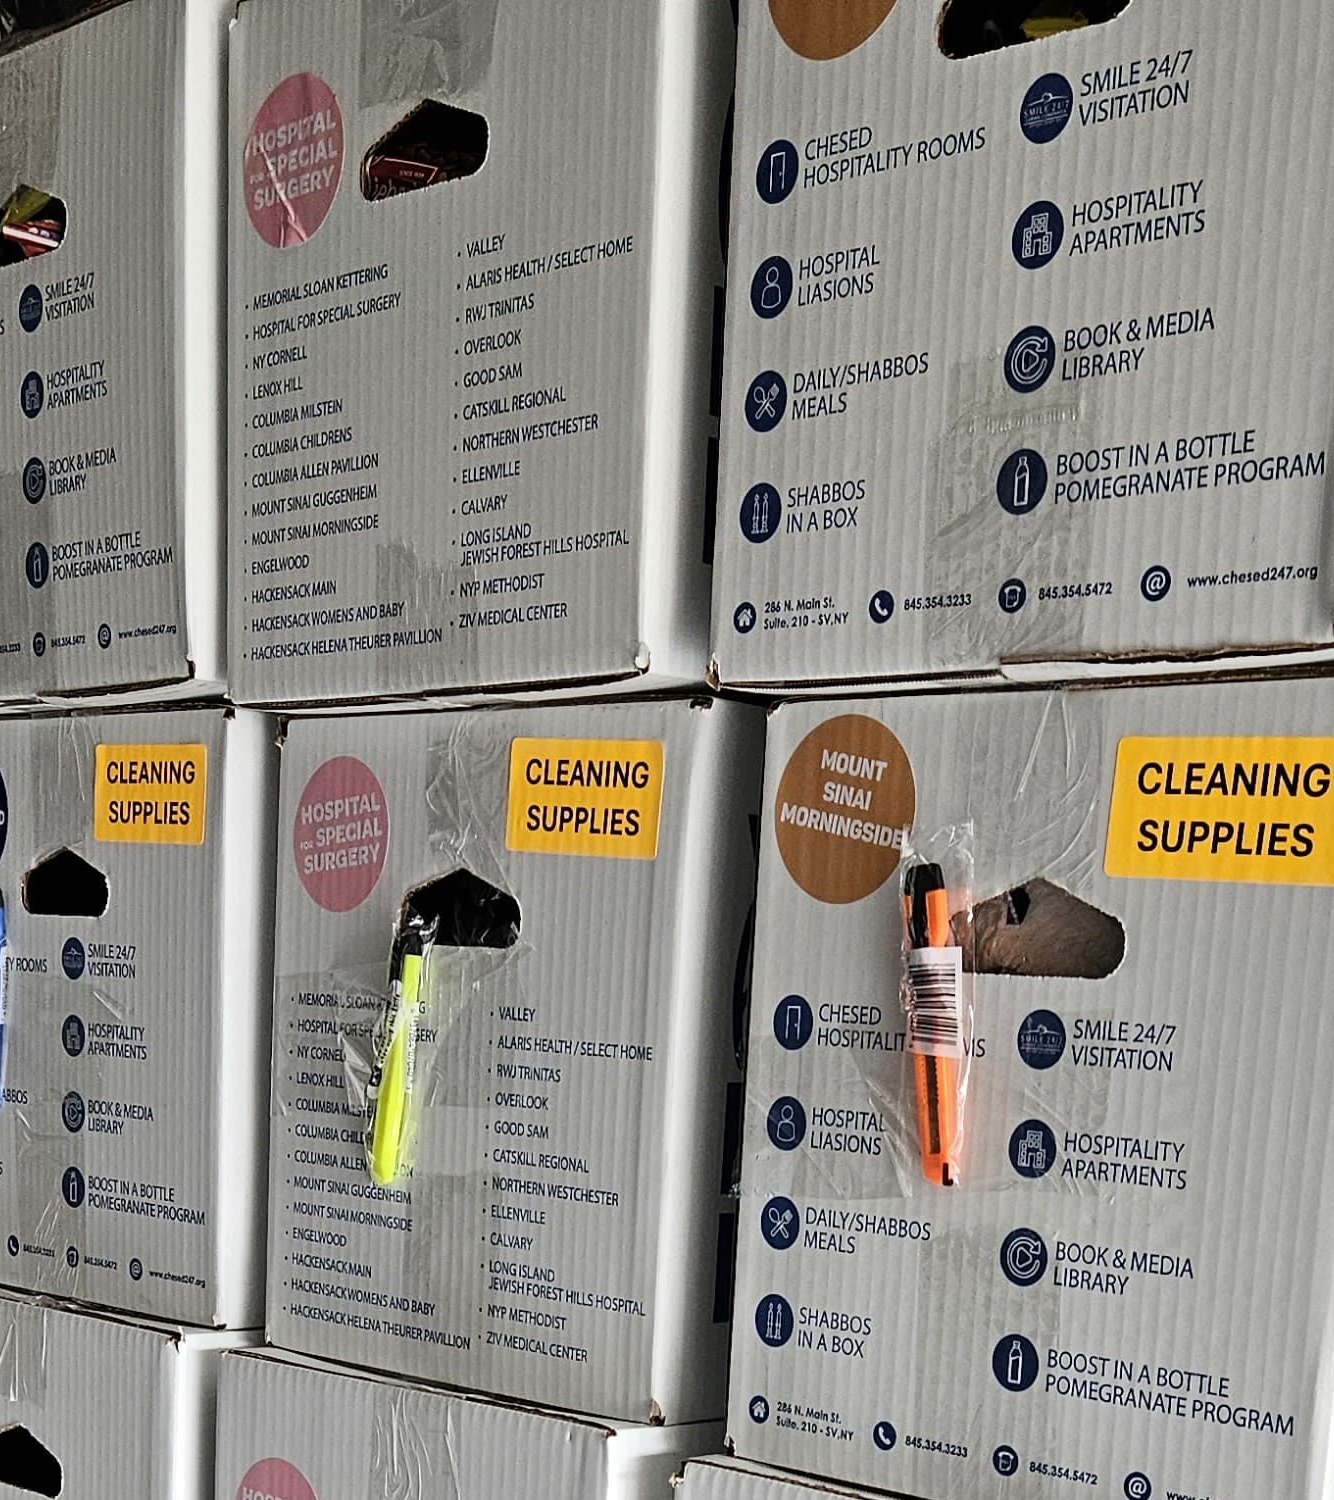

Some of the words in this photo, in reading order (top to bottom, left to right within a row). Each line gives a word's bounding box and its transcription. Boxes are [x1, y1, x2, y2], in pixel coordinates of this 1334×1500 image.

[805, 129, 872, 157] CHESED
[804, 145, 912, 186] HOSPITALITY
[918, 132, 985, 163] ROOMS
[794, 353, 928, 393] DAILY/SHABBOS
[792, 393, 846, 419] MEALS
[463, 428, 519, 452] NORTHERN
[522, 414, 597, 441] WESTCHESTER
[1188, 566, 1318, 587] www.chesed247.org
[107, 761, 195, 784] CLEANING
[526, 759, 648, 788] CLEANING
[821, 749, 887, 781] MOUNT
[1138, 763, 1330, 797] CLEANING
[302, 793, 380, 824] HOSPITAL
[823, 782, 871, 810] SINAI
[109, 801, 189, 825] SUPPLIES
[527, 805, 639, 836] SUPPLIES
[317, 820, 382, 846] SPECIAL
[781, 803, 906, 855] MORNINGSIDE
[1138, 820, 1314, 857] SUPPLIES
[305, 843, 379, 874] SURGERY
[88, 1023, 144, 1041] HOSPITALITY
[88, 1041, 146, 1060] APARTMENTS
[495, 1121, 524, 1136] GOOD
[527, 1124, 548, 1138] SAM
